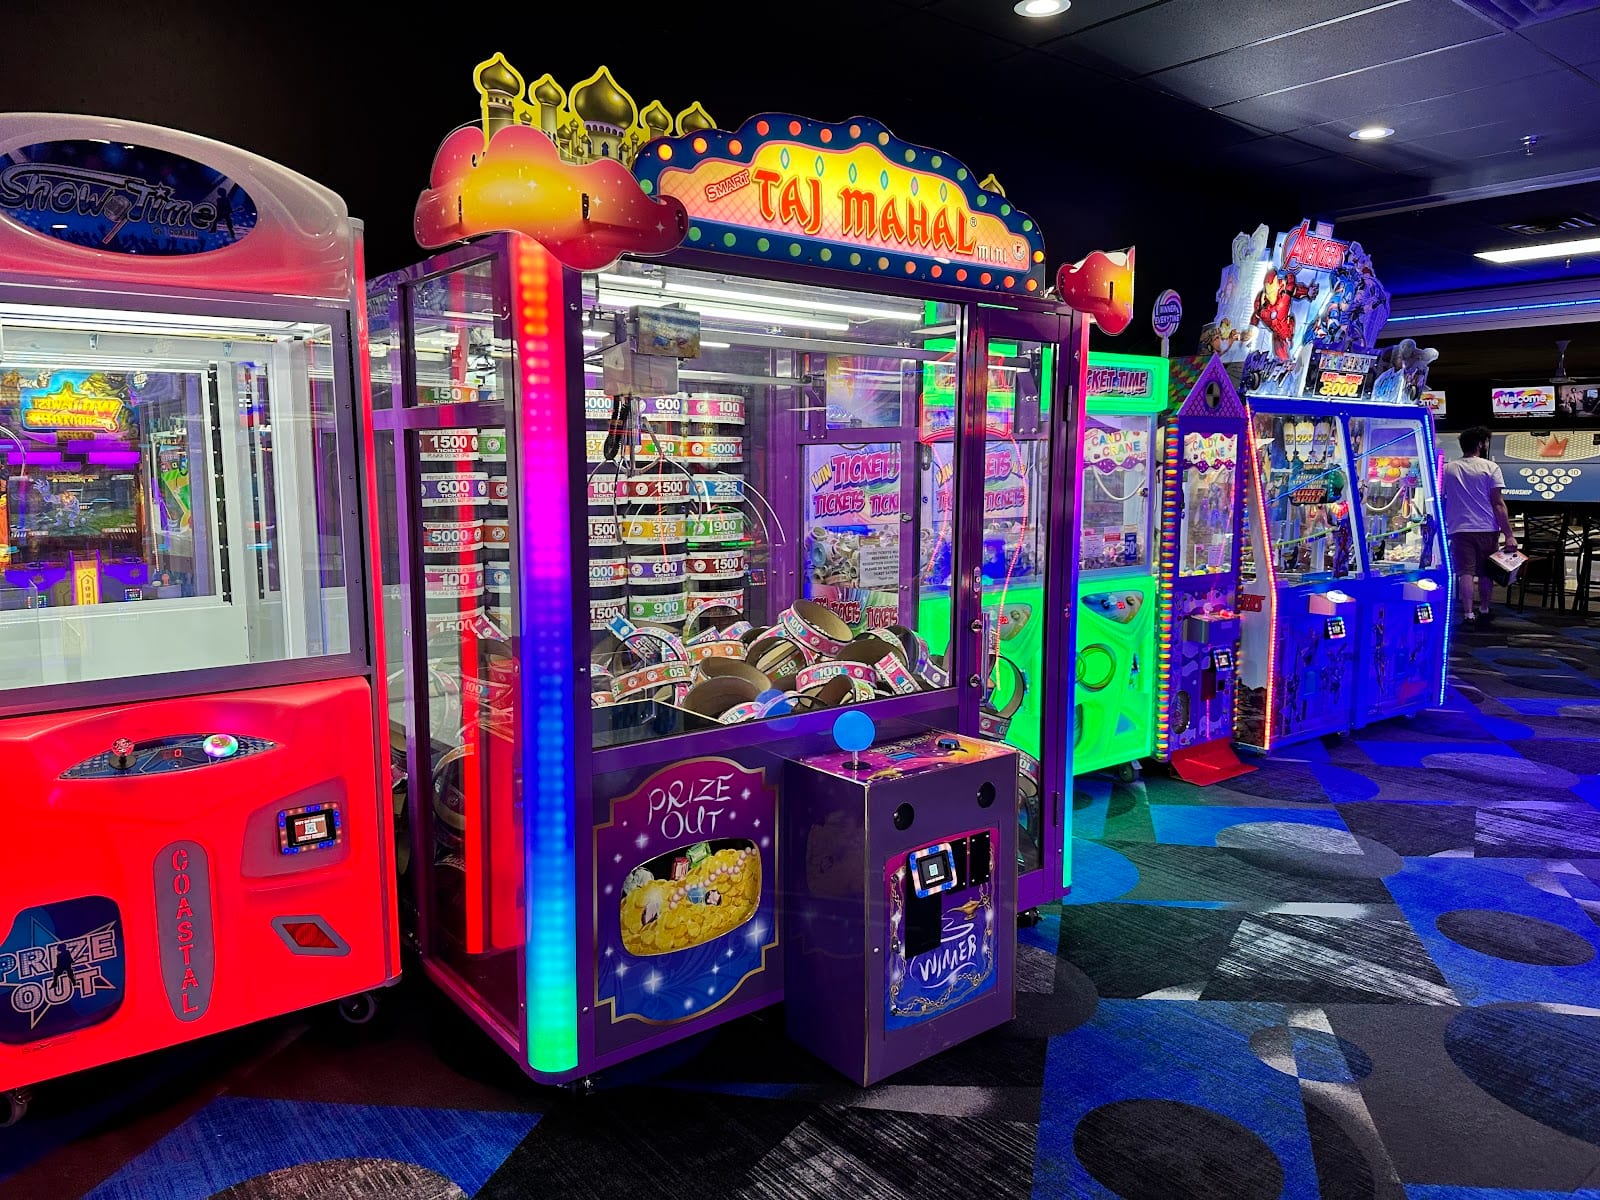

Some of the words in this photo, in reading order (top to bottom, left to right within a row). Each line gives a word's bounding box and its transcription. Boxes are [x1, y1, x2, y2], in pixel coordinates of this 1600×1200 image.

[706, 169, 750, 201] SMART
[0, 163, 118, 217] Show
[125, 180, 217, 230] Time
[752, 169, 822, 235] TAJ
[839, 187, 977, 255] MAHAL
[977, 244, 1007, 264] mini
[1087, 369, 1115, 393] CKET
[1118, 371, 1147, 395] TIME
[430, 386, 462, 400] 150
[1499, 394, 1547, 403] Welcome
[655, 398, 680, 410] 600
[717, 401, 739, 412] 100
[430, 435, 467, 448] 1500
[587, 439, 604, 451] 37
[1092, 431, 1128, 447] CANDY
[1192, 436, 1218, 450] CANDY
[710, 443, 736, 454] 5000
[1103, 441, 1141, 457] CRANE
[1200, 447, 1224, 460] CRANE
[811, 463, 832, 491] WIN
[437, 481, 470, 493] 600
[655, 482, 683, 494] 1500
[715, 482, 737, 492] 225
[814, 489, 865, 518] TICKETS
[869, 493, 899, 516] TICK
[985, 488, 1024, 512] TICKETS
[653, 522, 676, 533] 375
[714, 520, 736, 531] 900
[431, 529, 468, 542] 5000
[652, 562, 677, 574] 600
[713, 558, 738, 570] 1500
[440, 573, 470, 586] 100
[590, 606, 618, 619] 1500
[654, 602, 679, 613] 900
[866, 606, 898, 629] TICKETS
[436, 619, 472, 633] 1500
[788, 617, 804, 635] 100
[669, 667, 687, 677] 150
[775, 660, 797, 678] 150
[818, 665, 842, 677] 100
[648, 773, 734, 824] PRIZE
[661, 805, 724, 839] OUT
[172, 849, 199, 1015] COASTAL
[0, 929, 117, 985] PRIZE
[11, 966, 101, 1012] OUT
